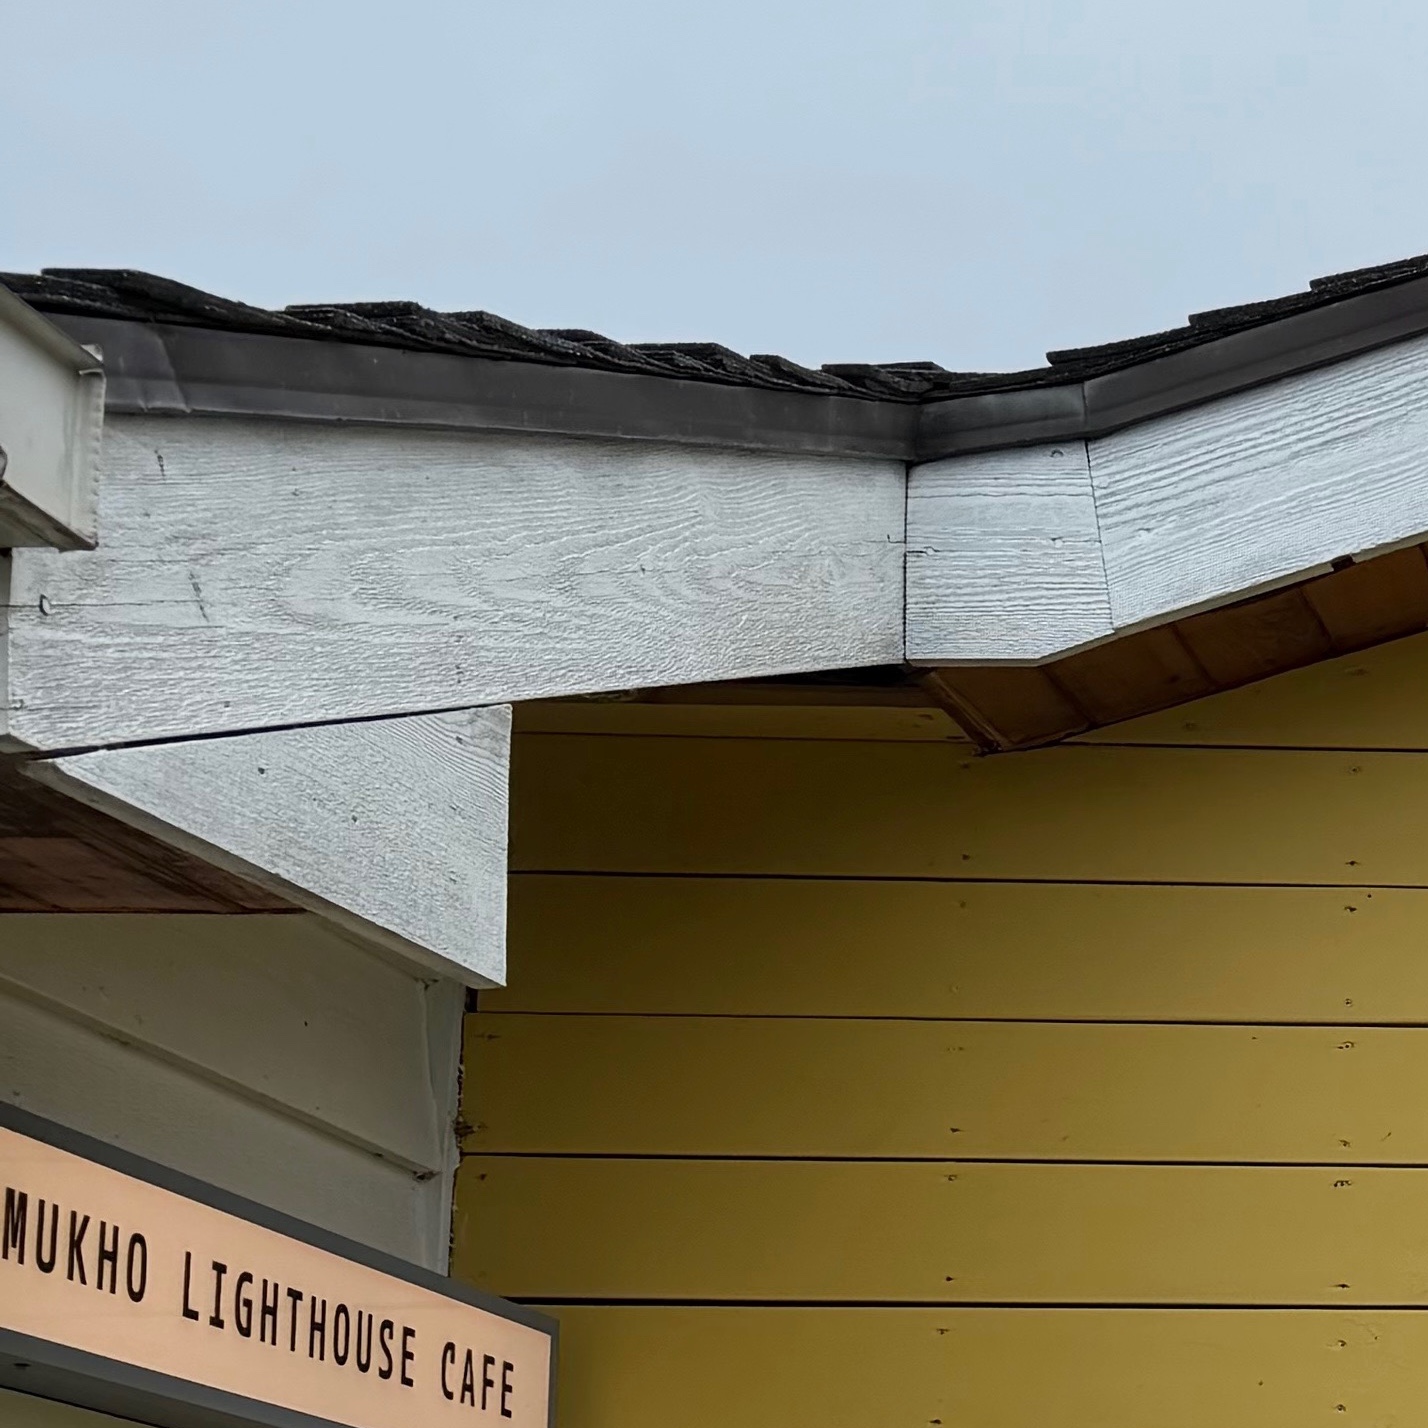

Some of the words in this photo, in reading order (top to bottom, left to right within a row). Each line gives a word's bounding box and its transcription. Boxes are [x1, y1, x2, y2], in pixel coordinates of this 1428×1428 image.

[1, 1187, 149, 1303] MUKHO
[181, 1250, 417, 1389] LIGHTHOUSE
[440, 1341, 516, 1419] CAFE
